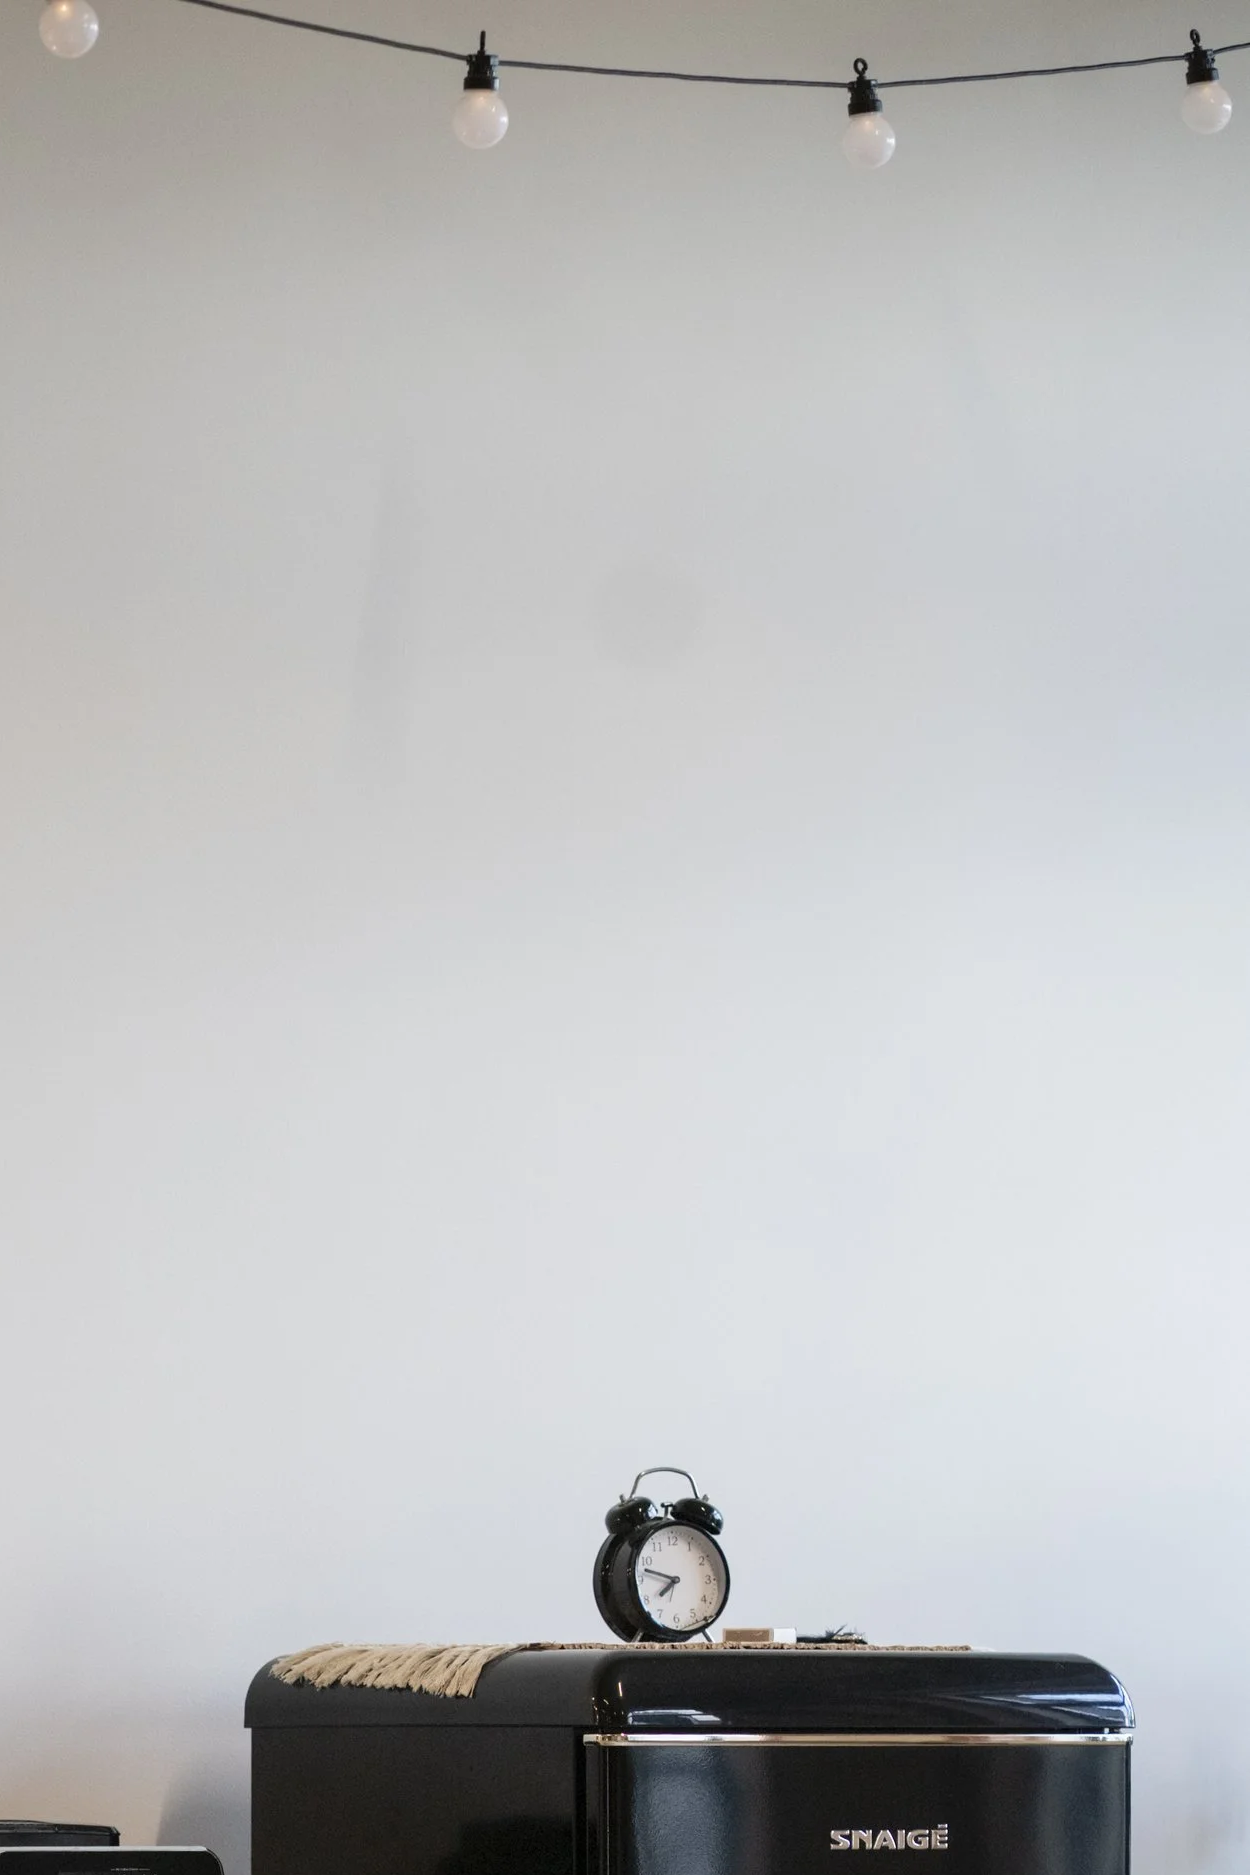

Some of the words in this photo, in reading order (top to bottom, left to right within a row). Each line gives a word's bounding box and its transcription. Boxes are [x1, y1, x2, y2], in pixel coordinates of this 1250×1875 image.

[668, 1536, 678, 1546] 12
[652, 1542, 662, 1552] 11
[641, 1556, 653, 1566] 10
[699, 1556, 705, 1566] 2
[705, 1575, 711, 1584] 3
[643, 1596, 650, 1604] 8
[701, 1595, 708, 1604] 4
[657, 1609, 663, 1618] 7
[690, 1609, 696, 1618] 5
[673, 1614, 680, 1623] 6
